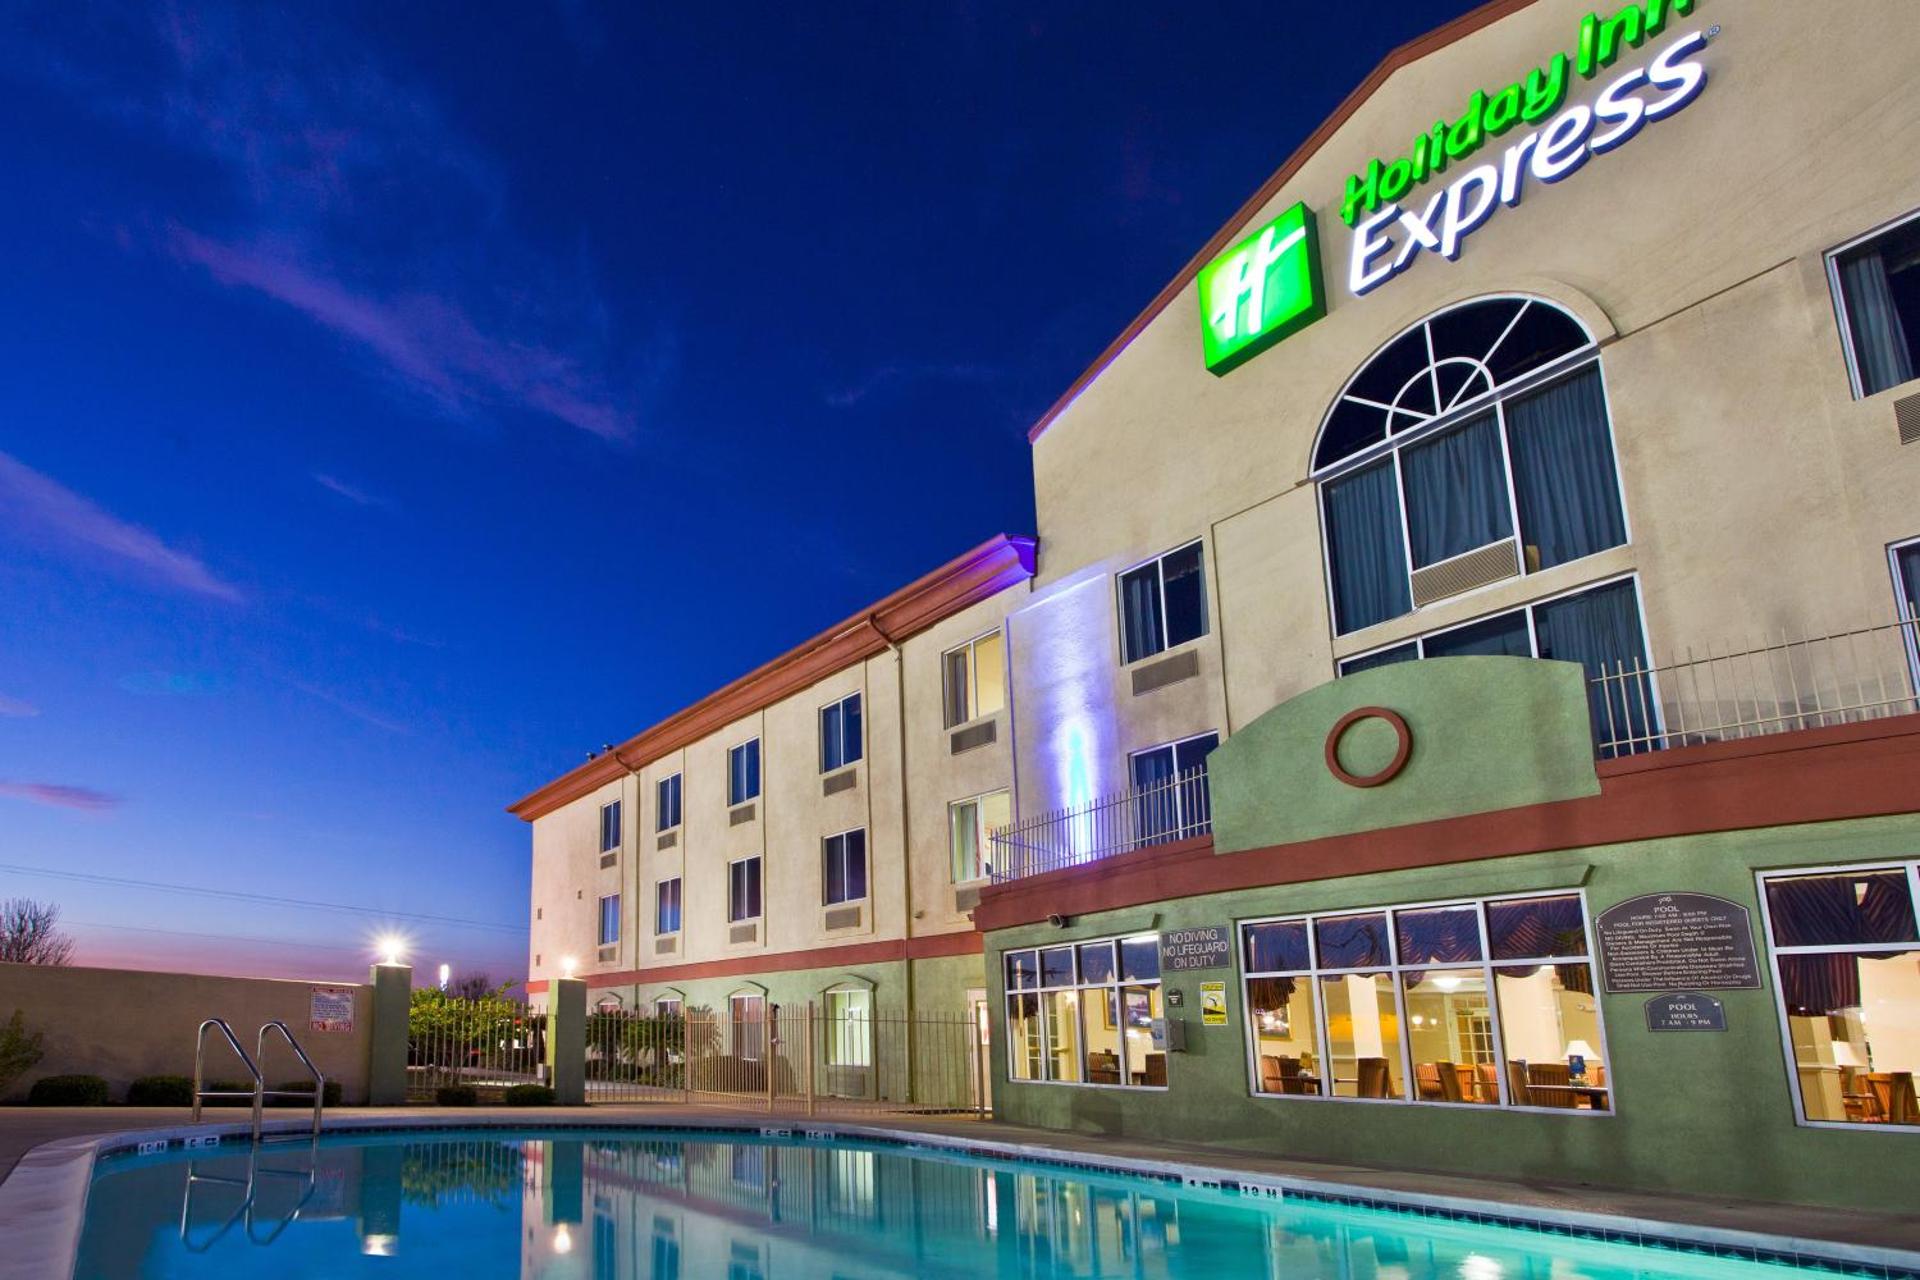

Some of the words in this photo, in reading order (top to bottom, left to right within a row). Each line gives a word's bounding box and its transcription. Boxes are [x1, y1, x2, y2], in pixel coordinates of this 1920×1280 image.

[1340, 53, 1570, 228] Holiday
[1349, 30, 1708, 297] Express
[1653, 905, 1680, 914] POOL
[1169, 932, 1183, 944] NO
[1184, 929, 1218, 943] DIVING
[1163, 946, 1176, 957] NO
[1177, 941, 1227, 956] LIFEGUARD
[1174, 957, 1188, 968] ON
[1189, 954, 1216, 967] DUTY
[1668, 1003, 1697, 1011] POOL
